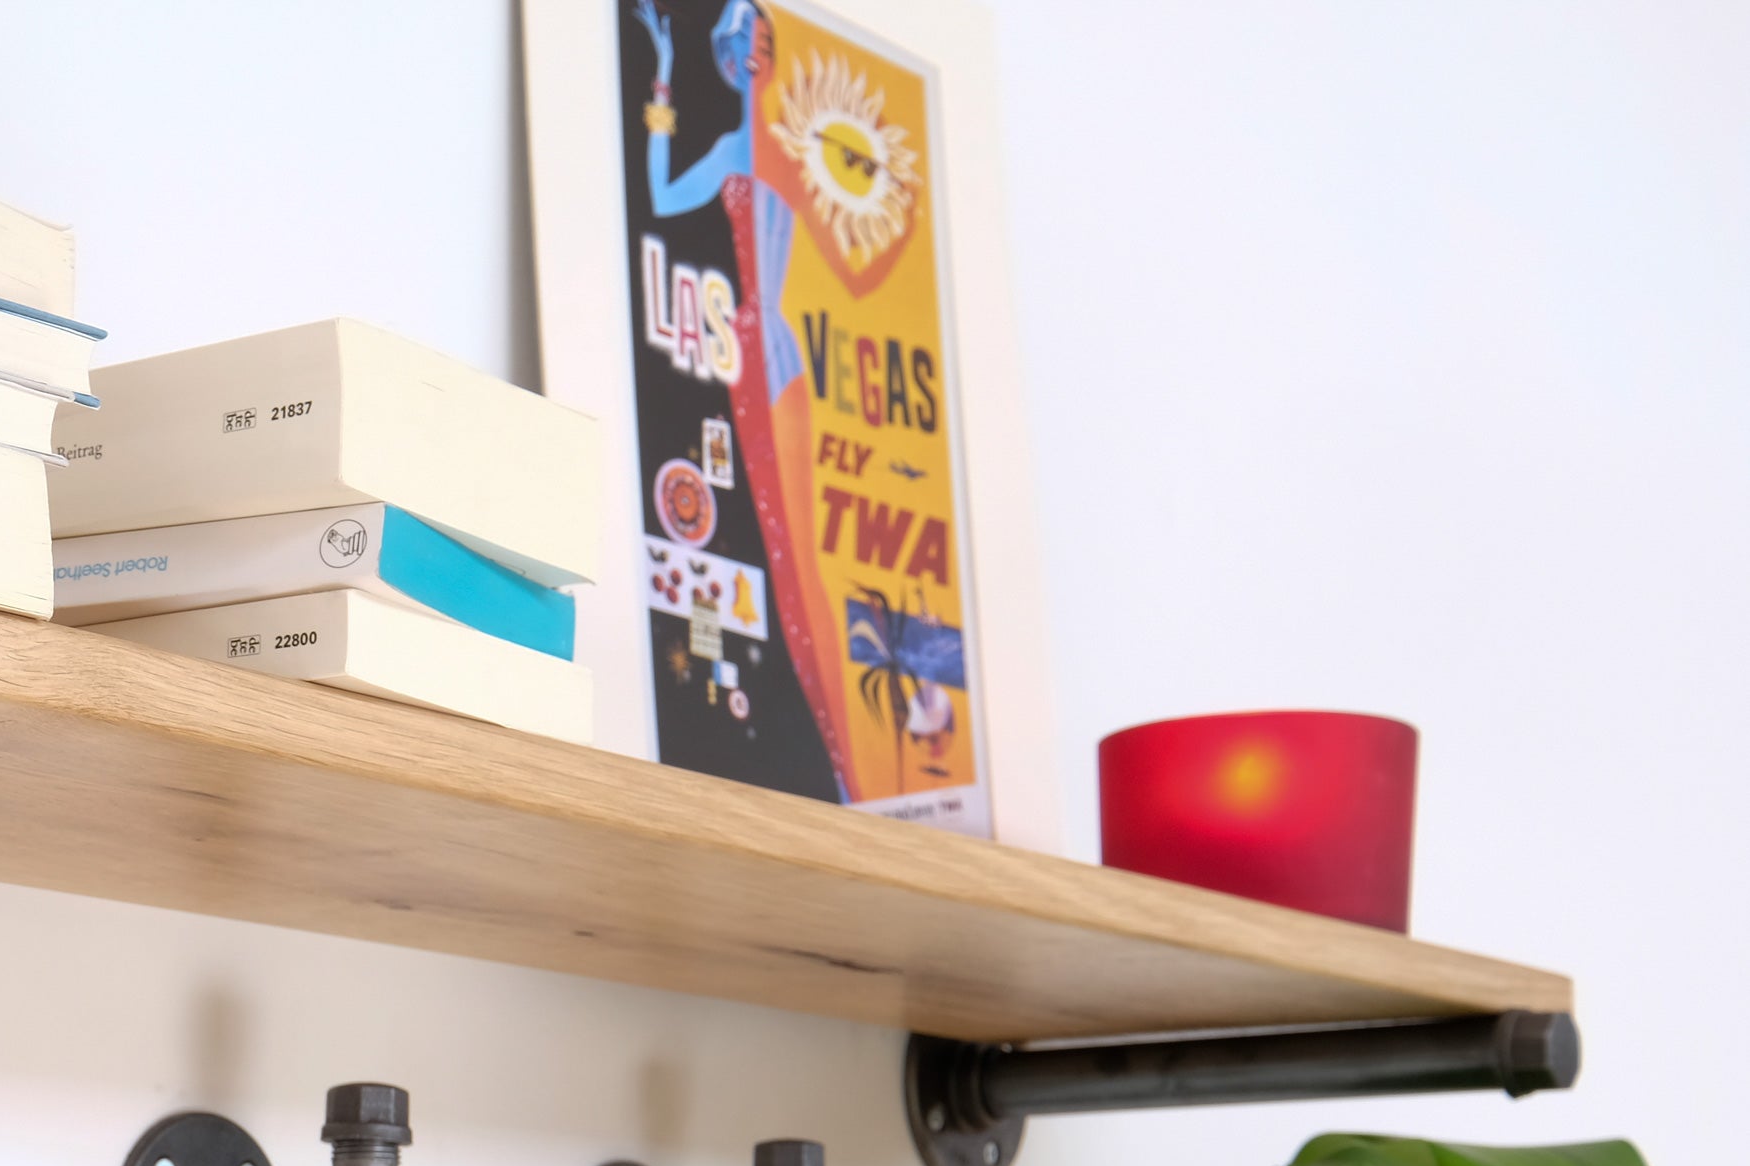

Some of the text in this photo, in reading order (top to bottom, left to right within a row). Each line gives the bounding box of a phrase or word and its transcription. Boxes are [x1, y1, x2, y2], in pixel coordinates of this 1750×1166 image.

[641, 233, 938, 434] LAS VEGAS
[271, 400, 312, 420] 21837
[57, 444, 102, 460] Beitrag
[817, 431, 875, 478] FLY
[822, 485, 950, 587] TWA
[114, 556, 168, 576] Robert
[274, 631, 317, 649] 22800
